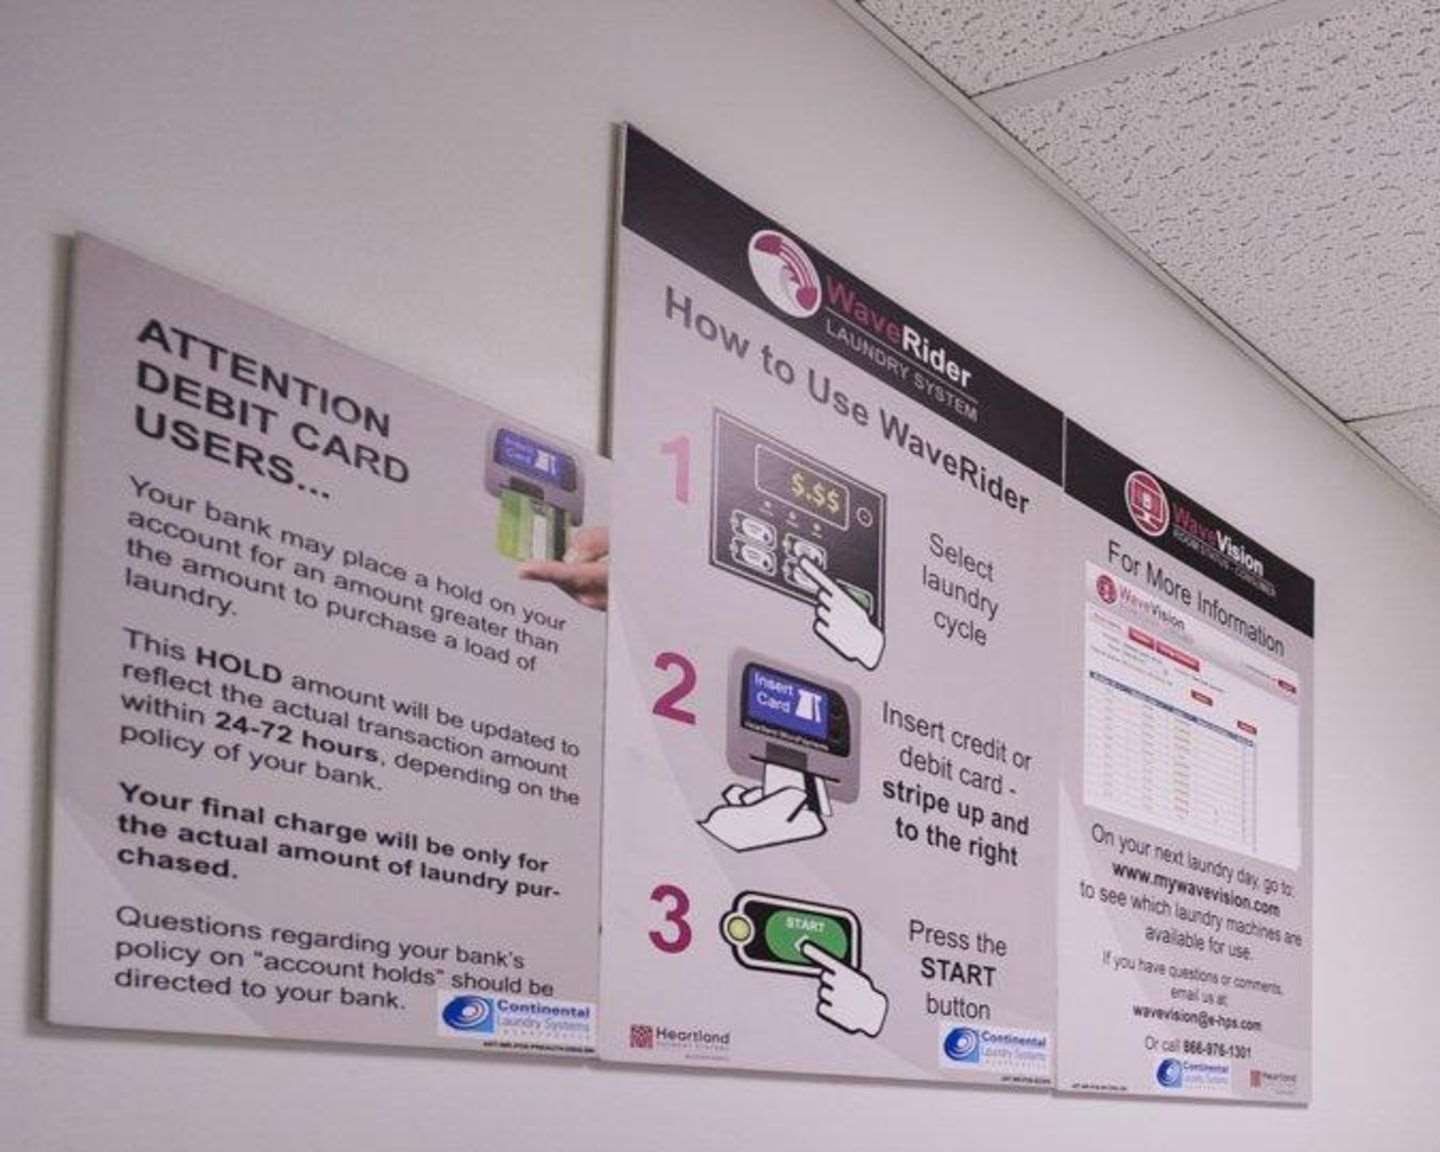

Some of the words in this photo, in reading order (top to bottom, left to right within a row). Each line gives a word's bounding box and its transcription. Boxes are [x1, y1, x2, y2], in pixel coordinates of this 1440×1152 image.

[826, 275, 972, 389] WaveRider
[136, 317, 391, 438] ATTENTION
[825, 318, 910, 381] LAUNDRY
[914, 372, 979, 423] SYSTEM
[136, 359, 278, 436] DEBIT
[292, 421, 411, 484] CARD
[665, 286, 750, 360] How
[761, 345, 795, 385] to
[807, 368, 869, 427] Use
[879, 408, 1031, 515] WaveRider
[135, 404, 331, 500] USERS...
[660, 433, 691, 507] 1
[130, 475, 197, 513] Your
[205, 501, 273, 539] bank
[280, 529, 335, 561] may
[343, 549, 407, 581] place
[415, 573, 428, 588] a
[436, 577, 483, 605] hold
[490, 599, 515, 616] on
[523, 607, 567, 631] your
[929, 532, 995, 582] Select
[125, 566, 237, 618] laundry.
[126, 538, 172, 567] the
[182, 557, 286, 601] amount
[294, 586, 318, 609] to
[326, 598, 436, 643] purchase
[444, 635, 457, 650] a
[464, 637, 509, 664] load
[517, 654, 537, 672] of
[127, 511, 242, 559] account
[250, 544, 285, 570] for
[293, 562, 325, 583] an
[334, 574, 423, 613] amount
[430, 604, 508, 638] greater
[516, 628, 559, 654] than
[921, 564, 999, 621] laundry
[1108, 540, 1142, 577] For
[1147, 562, 1192, 606] More
[1198, 590, 1285, 657] Information
[934, 609, 988, 647] cycle
[122, 626, 186, 661] This
[196, 645, 282, 684] HOLD
[291, 673, 386, 711] amount
[391, 699, 429, 721] will
[436, 707, 464, 730] be
[471, 718, 555, 752] updated
[561, 738, 580, 758] to
[652, 652, 696, 726] 2
[754, 672, 795, 697] Insert
[756, 690, 791, 714] Card
[120, 692, 205, 725] within
[214, 711, 292, 744] 24-72
[301, 729, 385, 767] hours,
[394, 752, 511, 795] depending
[517, 781, 543, 797] on
[550, 785, 580, 806] the
[121, 662, 212, 699] reflect
[221, 682, 263, 709] the
[272, 699, 349, 729] actual
[357, 715, 484, 760] transaction
[490, 747, 568, 779] amount
[882, 700, 945, 743] Insert
[951, 727, 1007, 763] credit
[1012, 749, 1032, 771] or
[899, 745, 953, 781] debit
[958, 763, 1003, 795] card
[119, 781, 193, 812] Your
[200, 795, 265, 825] final
[274, 812, 367, 845] charge
[375, 830, 418, 852] will
[426, 836, 454, 856] be
[461, 846, 511, 870] only
[518, 853, 550, 874] for
[882, 777, 950, 813] stripe
[957, 803, 984, 826] up
[991, 810, 1030, 836] and
[117, 846, 238, 879] chased.
[895, 817, 919, 841] to
[926, 825, 961, 852] the
[968, 837, 1019, 867] right
[1091, 823, 1114, 847] On
[1119, 836, 1150, 856] your
[1154, 844, 1184, 867] next
[1187, 852, 1234, 883] laundry
[1264, 878, 1279, 896] go
[1080, 880, 1095, 900] to
[1099, 887, 1126, 907] see
[1130, 892, 1172, 917] which
[1175, 901, 1223, 933] laundry
[1226, 914, 1281, 943] machines
[1283, 932, 1303, 948] are
[1111, 860, 1281, 917] www.mywavevision.com
[116, 905, 262, 941] Questions
[271, 926, 391, 959] regarding
[398, 940, 449, 961] your
[456, 945, 525, 969] bank's
[648, 884, 692, 955] 3
[785, 913, 826, 933] START
[909, 919, 969, 951] Press
[974, 932, 1007, 956] the
[1145, 926, 1204, 952] available
[1208, 936, 1225, 955] for
[114, 940, 200, 968] policy
[209, 951, 244, 968] on
[450, 972, 522, 995] should
[528, 978, 554, 997] be
[920, 956, 996, 987] START
[1102, 949, 1111, 965] If
[1113, 955, 1135, 971] you
[1138, 955, 1166, 976] have
[1168, 961, 1219, 985] questions
[1220, 972, 1232, 985] or
[1170, 984, 1200, 1002] email
[497, 999, 590, 1018] Continental
[926, 992, 991, 1020] button
[655, 1027, 730, 1046] Heartland
[981, 1030, 1046, 1047] Continental
[1144, 1035, 1159, 1051] Or
[1162, 1037, 1181, 1052] call
